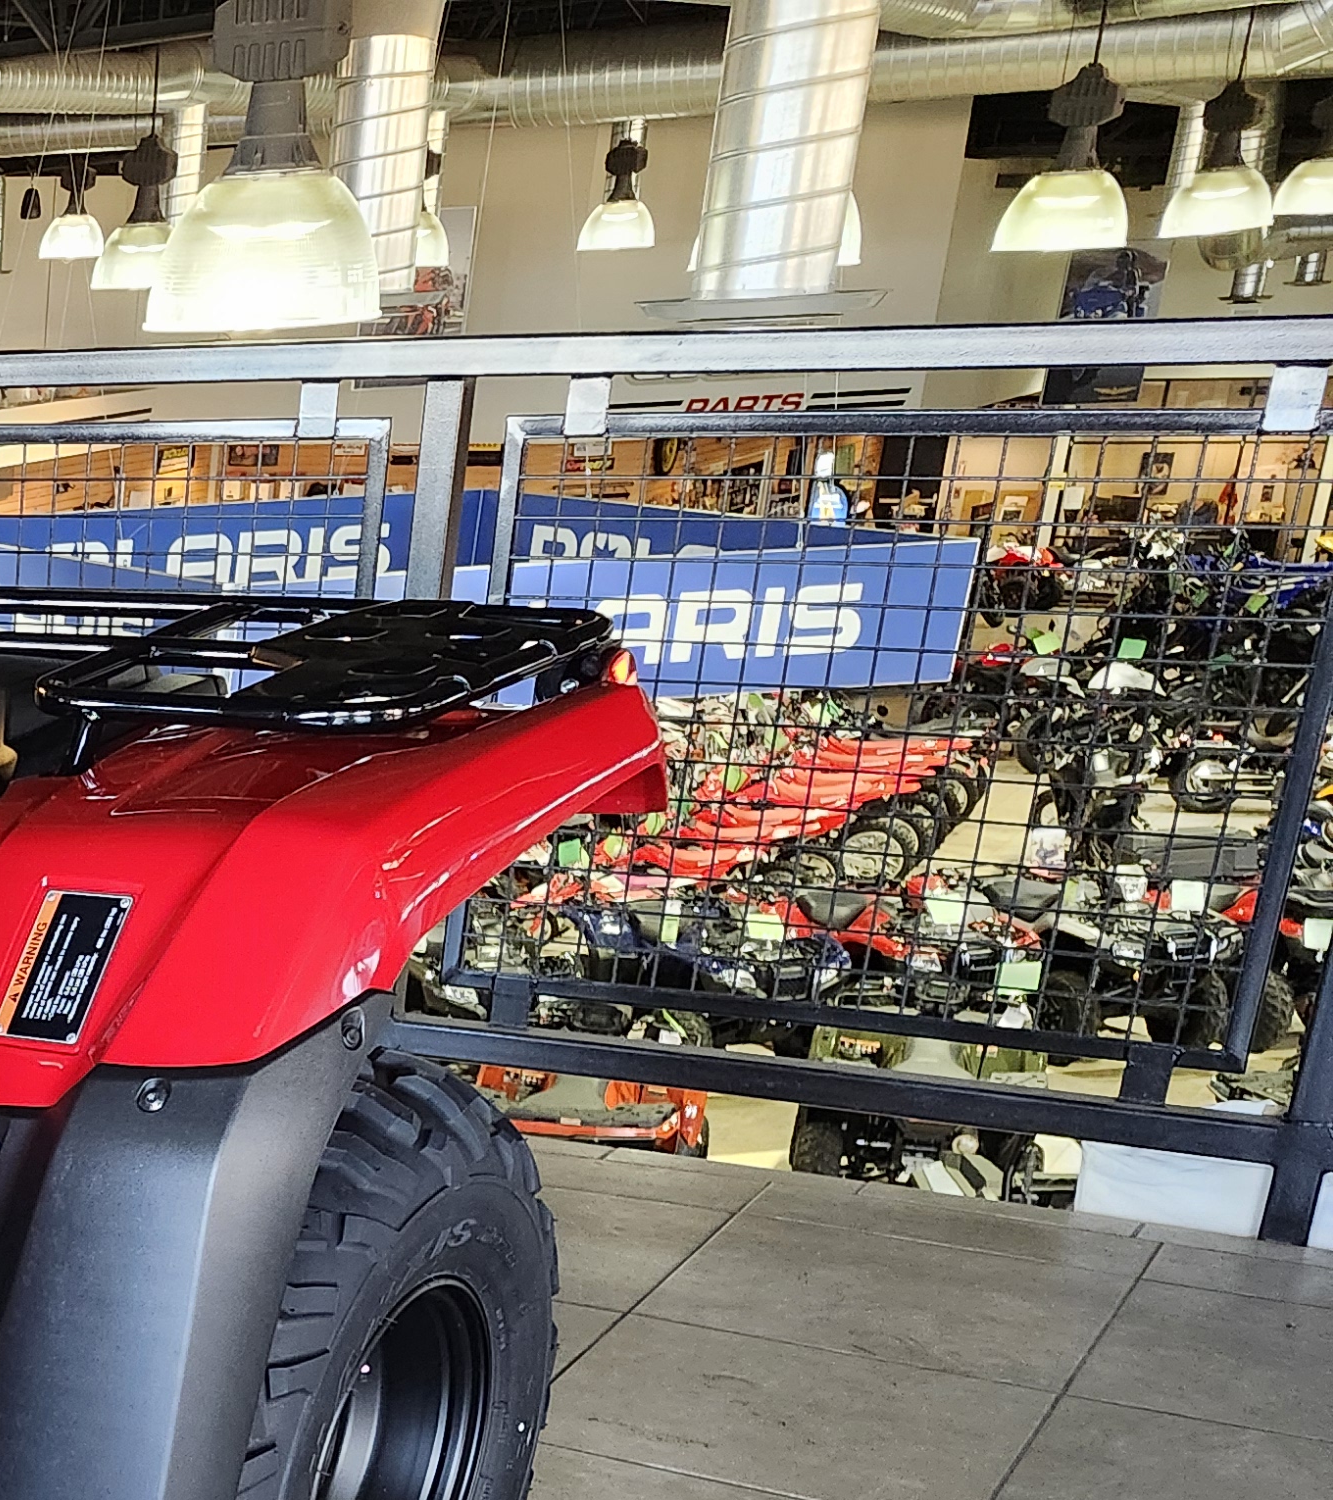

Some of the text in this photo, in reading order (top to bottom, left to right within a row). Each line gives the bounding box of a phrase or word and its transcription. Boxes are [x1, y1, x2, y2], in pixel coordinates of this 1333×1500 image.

[685, 393, 805, 412] PARTS
[593, 583, 864, 665] ARIS
[13, 921, 48, 987] WARNING
